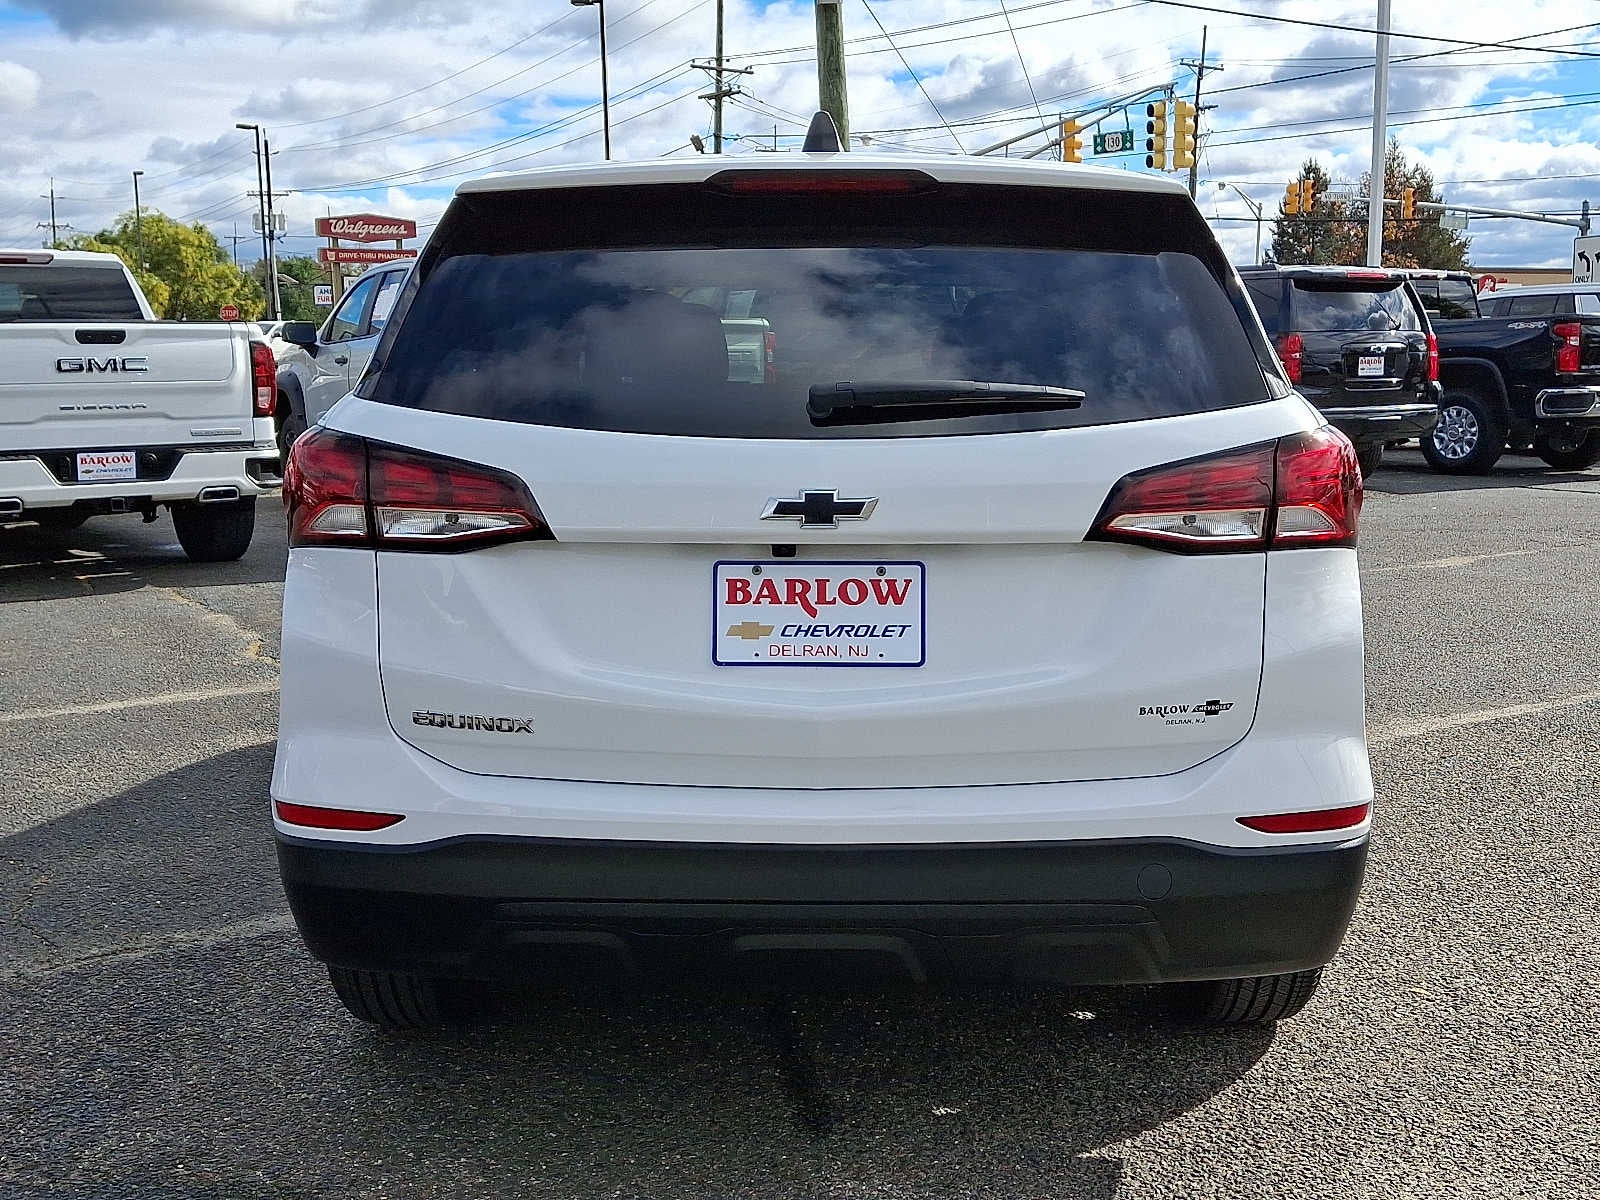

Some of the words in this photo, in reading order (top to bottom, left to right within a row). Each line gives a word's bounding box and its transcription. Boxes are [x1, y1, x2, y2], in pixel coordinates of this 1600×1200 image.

[1107, 136, 1120, 149] 130
[329, 219, 407, 238] Walgreens
[338, 251, 377, 259] DRIVE-THRU
[1575, 274, 1590, 283] ONLY
[221, 309, 237, 317] STOP
[56, 357, 148, 373] GMC
[80, 455, 133, 467] BARLOW
[725, 578, 912, 618] BARLOW
[780, 624, 912, 637] CHEVROLET
[769, 645, 843, 658] DELRAN,
[848, 644, 869, 657] NJ
[1139, 705, 1190, 718] BARLOW
[1194, 704, 1230, 712] CHEVROLET
[412, 710, 535, 733] EQUINOX
